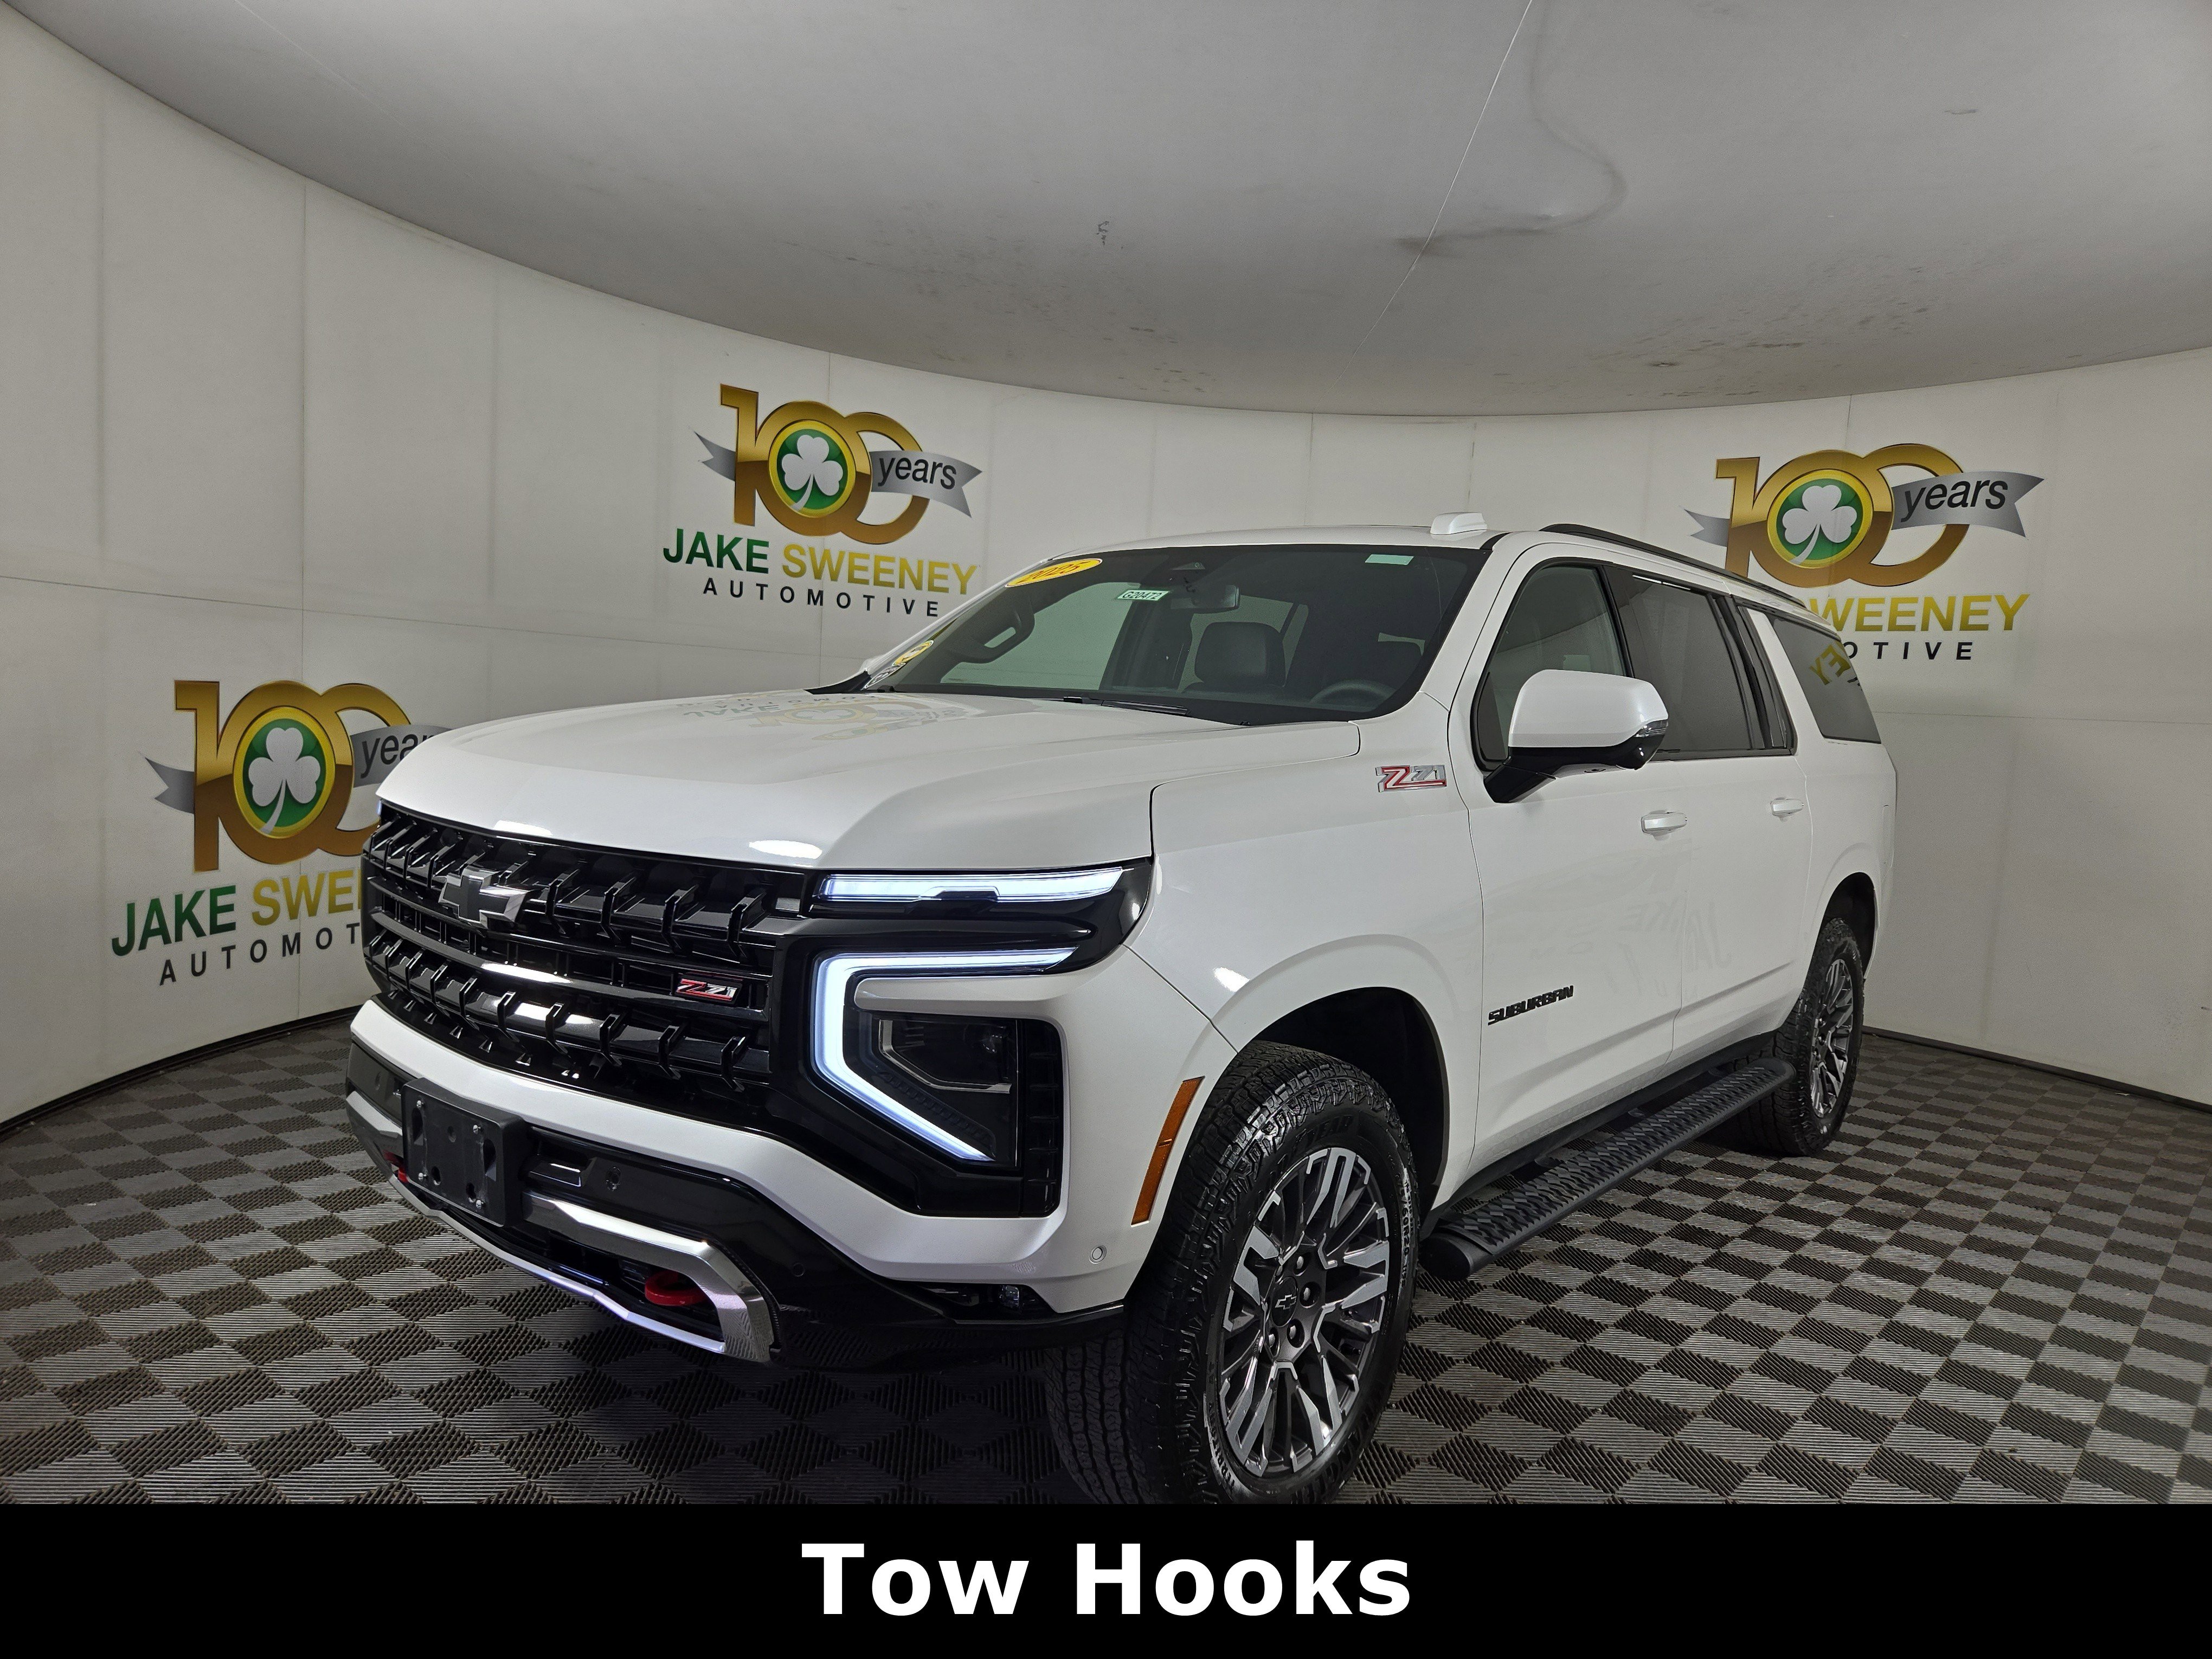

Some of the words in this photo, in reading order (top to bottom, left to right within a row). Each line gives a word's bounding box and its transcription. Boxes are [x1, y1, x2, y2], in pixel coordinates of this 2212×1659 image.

[721, 383, 930, 545] 100
[878, 457, 957, 490] years
[1715, 443, 1972, 588] 100
[1900, 479, 2008, 522] years
[663, 528, 769, 574] JAKE
[782, 544, 977, 595] SWEENEY
[703, 577, 938, 617] AUTOMOTIVE
[360, 734, 435, 779] yea
[1375, 764, 1447, 793] Z71
[112, 885, 236, 956] JAKE
[252, 867, 362, 926] SWE
[677, 978, 738, 1001] Z71
[1488, 985, 1574, 1026] SUBURBAN
